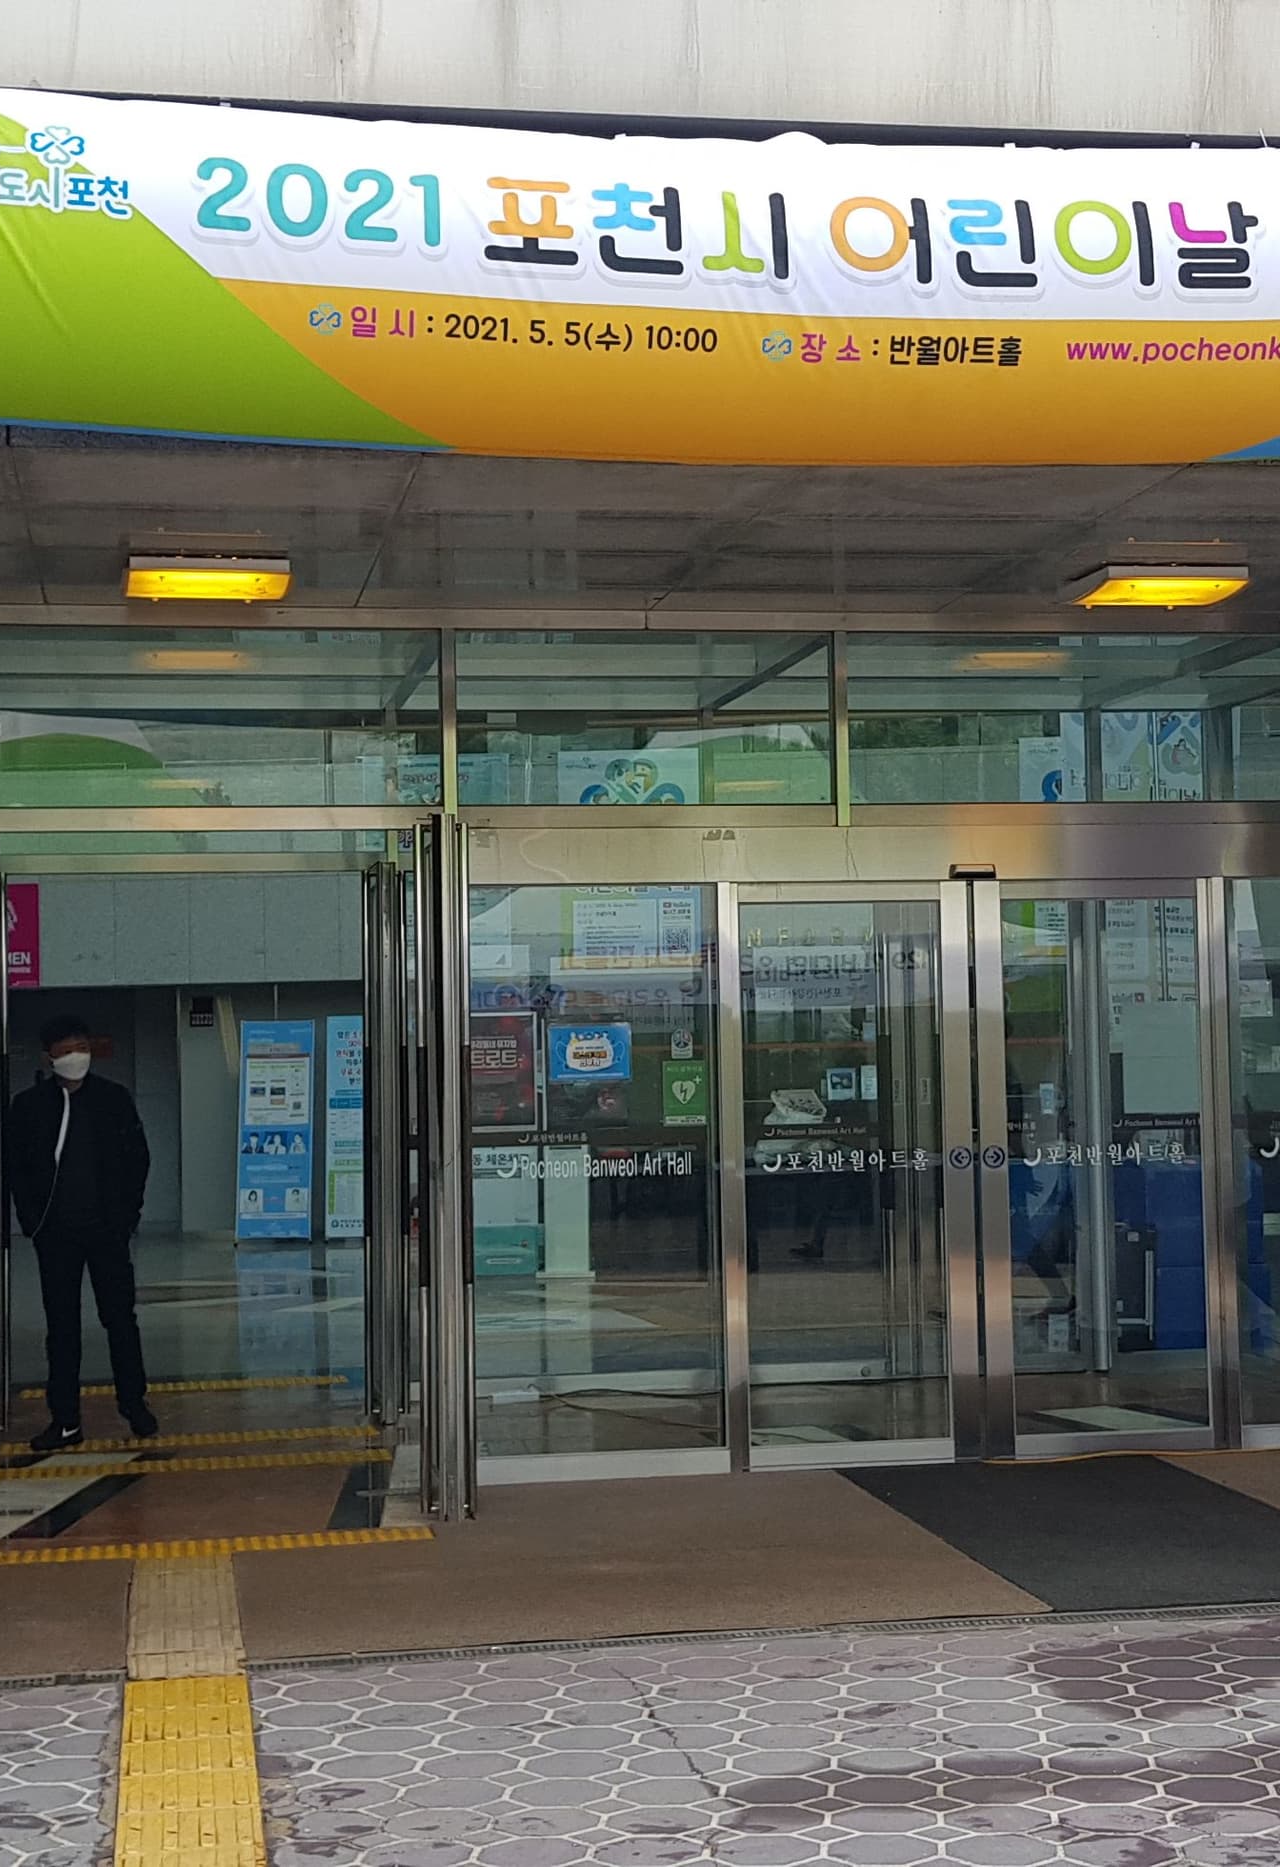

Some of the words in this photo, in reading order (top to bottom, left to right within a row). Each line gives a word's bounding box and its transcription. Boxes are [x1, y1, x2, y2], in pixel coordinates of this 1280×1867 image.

[197, 156, 441, 247] 2021
[483, 175, 790, 281] 포천시
[829, 195, 1259, 290] 어린이날
[444, 313, 520, 344] 2021.
[528, 318, 555, 347] 5.
[563, 319, 635, 353] 5(수)
[644, 324, 719, 354] 10:00
[887, 334, 1023, 367] 반월아트홀
[521, 1155, 578, 1179] Pocheon
[583, 1152, 638, 1178] Banweol
[642, 1151, 663, 1177] Art
[667, 1151, 693, 1176] Hall
[785, 1147, 929, 1173] 포천반월아트홀
[1046, 1142, 1186, 1168] 포천반월아트홀
